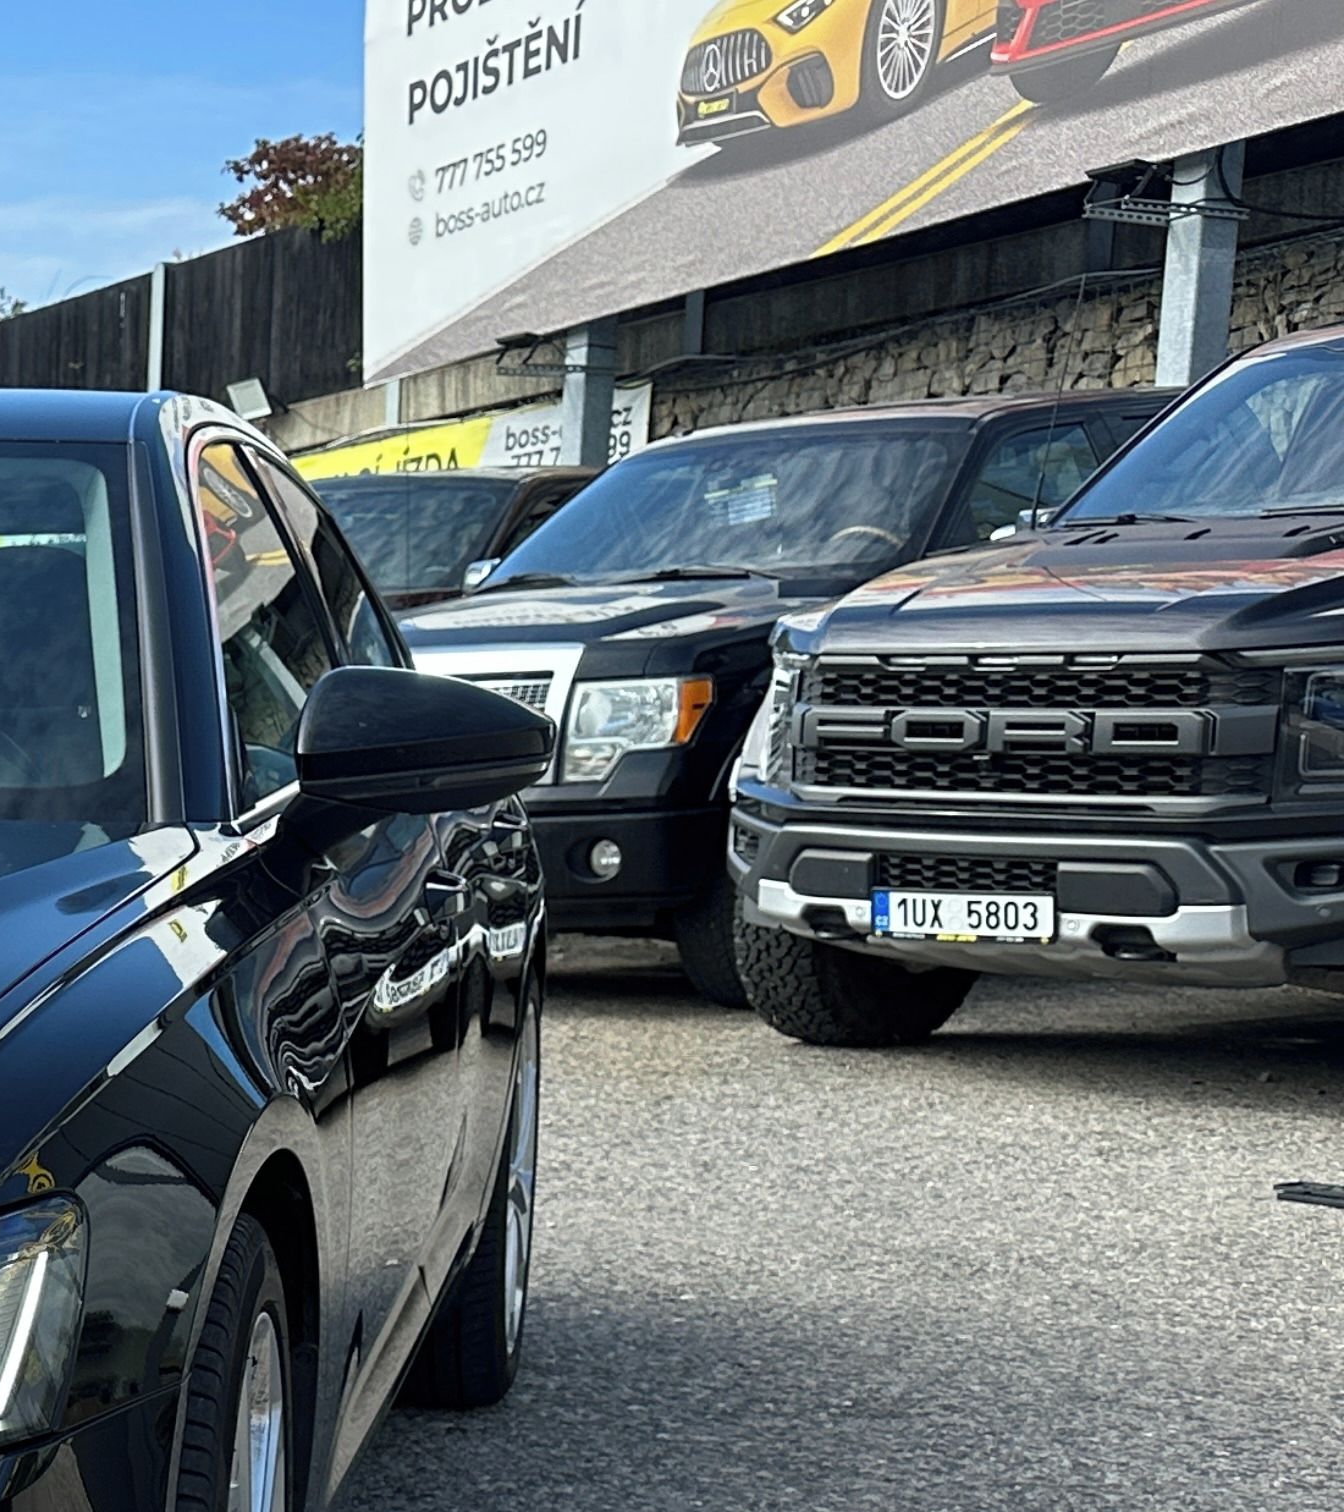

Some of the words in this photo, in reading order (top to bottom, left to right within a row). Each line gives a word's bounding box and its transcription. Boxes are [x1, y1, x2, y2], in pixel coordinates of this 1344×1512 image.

[408, 0, 584, 125] POJIŠTĚNÍ
[435, 158, 468, 194] 777
[472, 143, 506, 181] 755
[510, 128, 548, 166] 599
[435, 181, 546, 238] boss-auto.cz
[803, 708, 1216, 755] FORD
[897, 897, 944, 928] 1UX
[967, 900, 1038, 931] 5803
